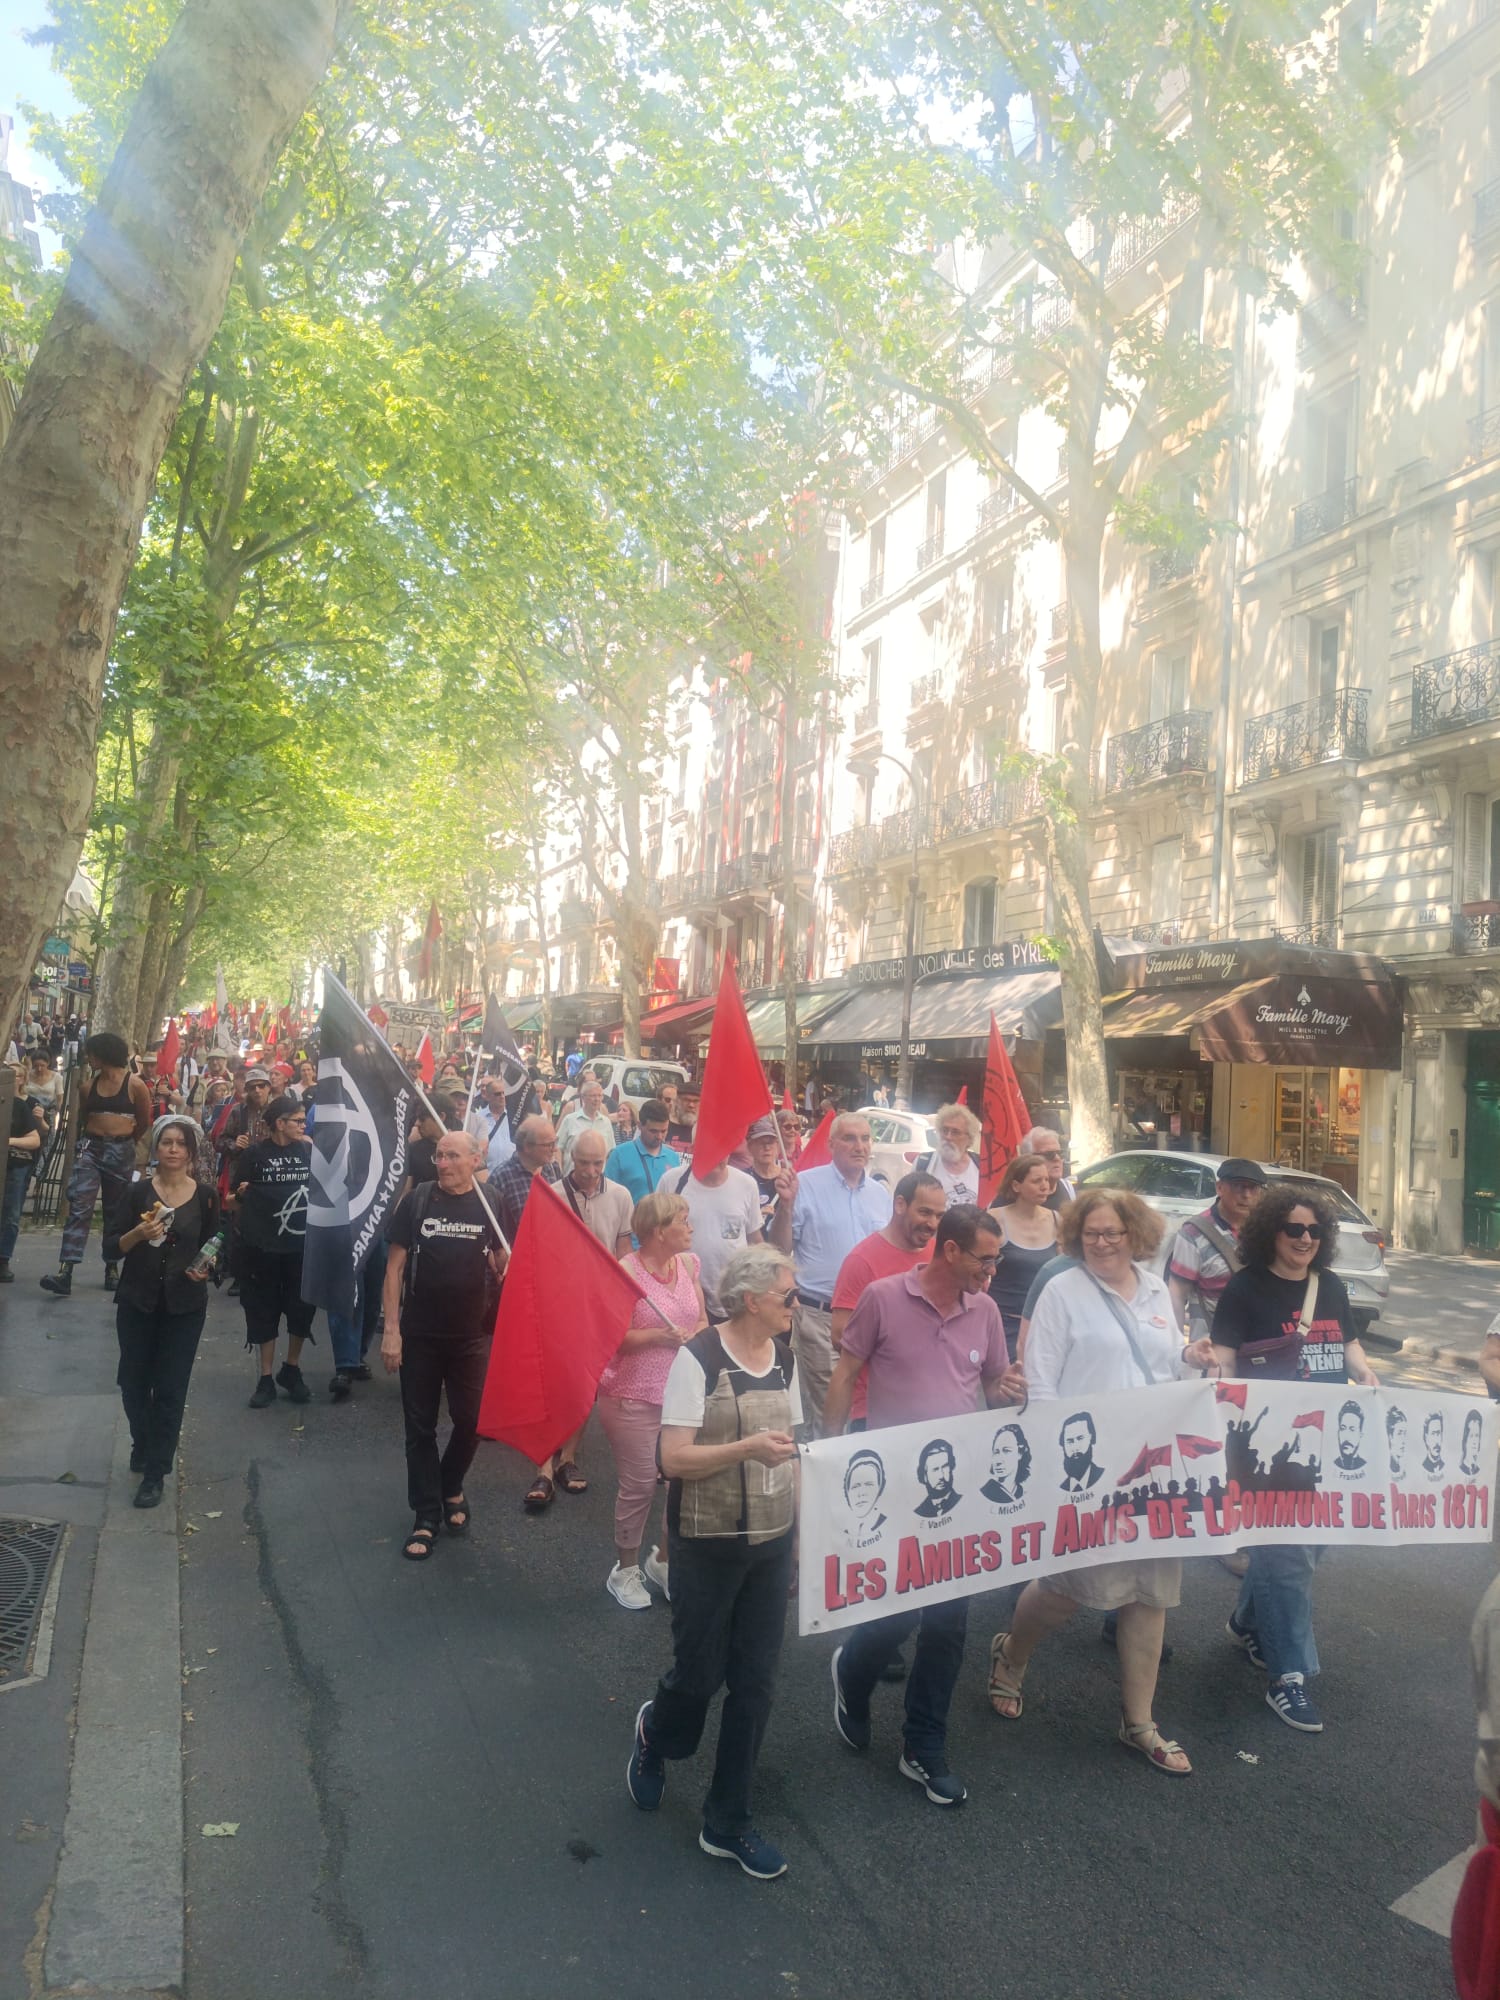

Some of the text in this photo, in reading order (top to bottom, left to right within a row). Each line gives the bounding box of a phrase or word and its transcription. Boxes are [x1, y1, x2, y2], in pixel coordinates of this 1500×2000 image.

[858, 960, 907, 983] BOUCHERI
[983, 947, 1005, 969] des
[1145, 949, 1239, 979] Famille Mary
[1255, 1004, 1353, 1035] Famille Mary
[861, 1042, 926, 1057] Maison SIMOEAU
[1070, 1491, 1095, 1504] Vallès
[998, 1499, 1026, 1516] Michel
[927, 1515, 953, 1530] Varlin
[824, 1553, 887, 1611] LES
[895, 1530, 1002, 1595] AMIES
[1010, 1520, 1046, 1566] ET
[1052, 1503, 1139, 1557] AMIS
[1146, 1497, 1195, 1540] DE
[1227, 1478, 1345, 1534] COMMUNE
[1351, 1491, 1387, 1530] DE
[1390, 1482, 1438, 1531] PARIS
[1441, 1483, 1489, 1530] 1871
[856, 1531, 883, 1549] Lemel
